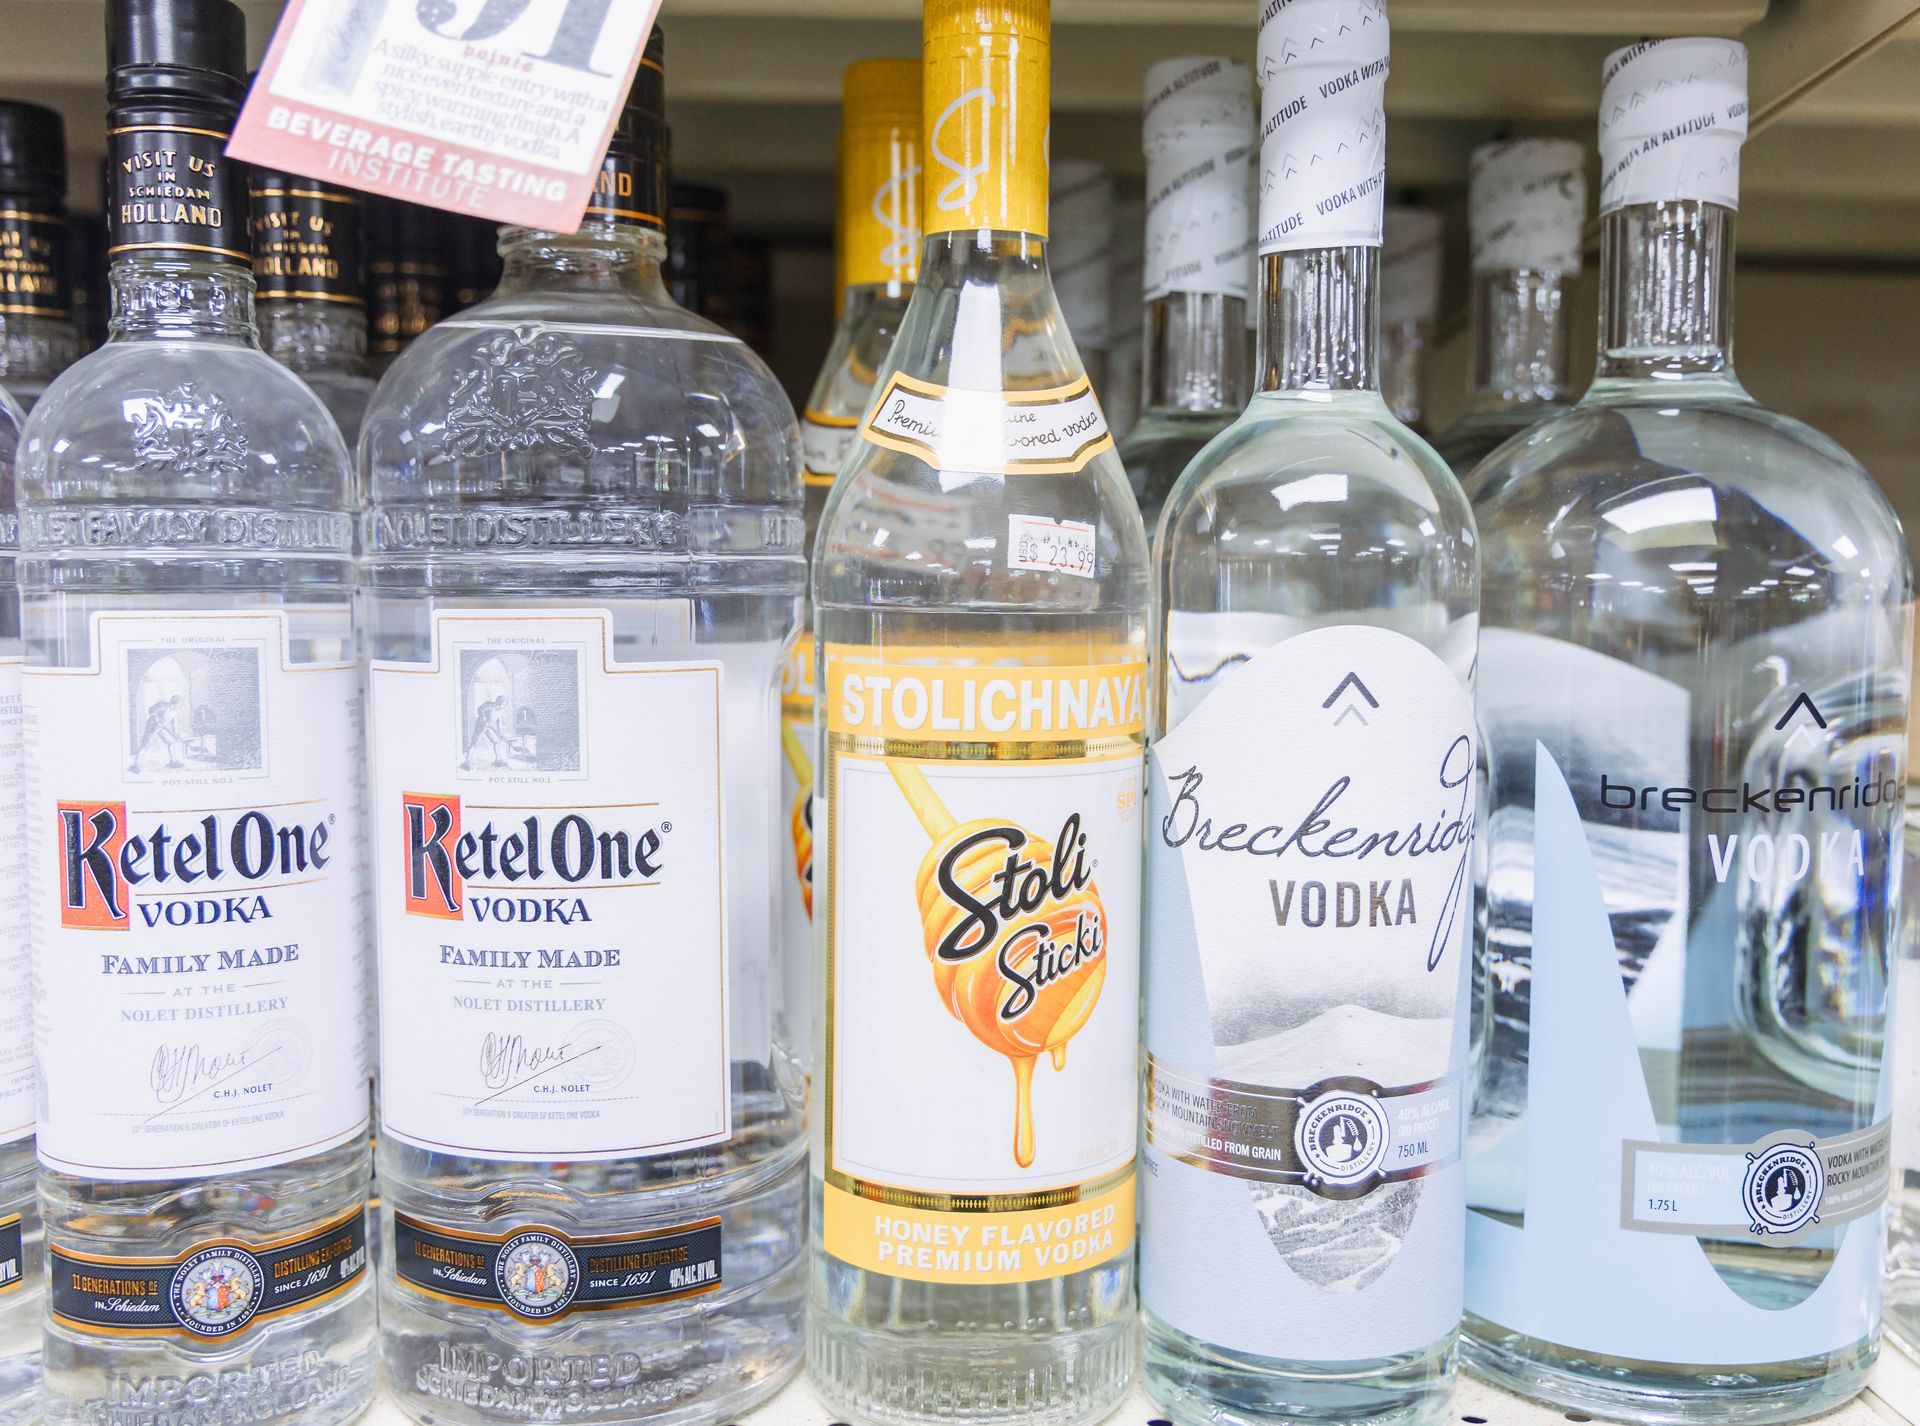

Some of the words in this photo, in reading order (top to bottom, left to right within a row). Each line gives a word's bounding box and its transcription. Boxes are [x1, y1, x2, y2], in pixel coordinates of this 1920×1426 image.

[1619, 42, 1647, 68] WITH
[374, 38, 388, 56] A
[437, 58, 498, 84] supple
[501, 75, 552, 101] entry
[553, 87, 595, 109] with
[373, 80, 423, 106] spicy
[425, 92, 510, 131] warming
[423, 74, 466, 96] even
[470, 84, 535, 112] texture
[536, 104, 575, 124] and
[1263, 95, 1308, 138] ALTITUDE
[1319, 69, 1360, 98] VODKA
[440, 117, 502, 147] earthy
[1642, 136, 1659, 153] AN
[122, 150, 178, 174] VISIT
[188, 154, 216, 178] US
[266, 106, 438, 171] BEVERAGE
[440, 152, 569, 204] TASTING
[157, 170, 176, 183] IN
[327, 147, 493, 211] INSTITUTE
[128, 185, 211, 200] SCHIEDAM
[1315, 187, 1357, 216] VODKA
[120, 202, 223, 228] HOLLAND
[1062, 412, 1098, 438] vodka
[1048, 544, 1094, 573] 23.99
[160, 636, 179, 644] THE
[181, 636, 226, 644] ORIGINAL
[842, 673, 1143, 732] STOLICHNAYA
[163, 778, 180, 787] POT
[183, 778, 210, 787] STILL
[488, 776, 505, 784] POT
[507, 776, 530, 784] STILL
[60, 806, 224, 922] Ketel
[404, 803, 544, 912] Ketel
[1707, 828, 1865, 884] VODKA
[136, 894, 274, 928] VODKA
[468, 896, 593, 926] VODKA
[1268, 878, 1418, 929] VODKA
[102, 953, 211, 975] FAMILY
[218, 943, 300, 971] MADE
[440, 944, 533, 968] FAMILY
[537, 948, 621, 968] MADE
[993, 914, 1102, 1022] Sticki
[173, 986, 195, 997] AT
[201, 983, 237, 994] THE
[496, 978, 515, 988] AT
[522, 978, 553, 989] THE
[121, 1007, 180, 1023] NOLET
[186, 996, 289, 1020] DISTILLERY
[454, 995, 502, 1011] NOLET
[507, 998, 606, 1012] DISTILLERY
[213, 1088, 240, 1099] C.H.J.
[243, 1083, 274, 1095] NOLET
[533, 1084, 558, 1094] C.H.J.
[561, 1084, 591, 1093] NOLET
[1171, 1087, 1191, 1103] WITH
[1192, 1094, 1224, 1113] WATER
[1227, 1102, 1257, 1120] FROM
[1171, 1103, 1215, 1129] MOUNTAIN
[1218, 1118, 1279, 1139] SNOWMELT
[1308, 1103, 1369, 1152] BRECKENRIDGE
[1224, 1141, 1250, 1157] FROM
[1251, 1145, 1282, 1161] GRAIN
[1340, 1141, 1376, 1172] DISTILLERY
[1398, 1142, 1415, 1159] 750
[1416, 1141, 1429, 1155] ML
[1827, 1152, 1853, 1169] VODKA
[1853, 1146, 1870, 1163] WITH
[1755, 1155, 1807, 1204] BRECKENRIDGE
[1826, 1169, 1851, 1187] ROCKY
[1648, 1198, 1670, 1211] 1.75
[1672, 1199, 1678, 1212] L
[1782, 1189, 1812, 1220] DISTILLERY
[875, 1215, 970, 1247] HONEY
[981, 1203, 1116, 1248] FLAVORED
[274, 1250, 320, 1279] DISTILLING
[421, 1243, 475, 1269] GENERATIONS
[502, 1240, 520, 1260] NOLET
[521, 1235, 550, 1244] FAMILY
[550, 1241, 577, 1279] DISTILLERY
[878, 1241, 1021, 1273] PREMIUM
[1035, 1228, 1114, 1269] VODKA
[81, 1276, 146, 1296] GENERATIONS
[173, 1282, 181, 1299] THE
[177, 1258, 199, 1282] NOLET
[200, 1250, 233, 1261] FAMILY
[233, 1252, 261, 1288] DISTILLERY
[274, 1279, 302, 1294] SINCE
[303, 1264, 332, 1287] 1691
[432, 1267, 441, 1277] IN
[441, 1265, 488, 1285] Schiedam
[589, 1278, 619, 1288] SINCE
[620, 1269, 657, 1287] 1691
[669, 1267, 684, 1288] 40%
[94, 1300, 104, 1310] IN
[104, 1297, 161, 1312] Schiedam
[506, 1295, 541, 1314] FOUNDED
[185, 1314, 224, 1333] FOUNDED
[226, 1320, 236, 1329] IN
[439, 1341, 641, 1387] IMPORTED
